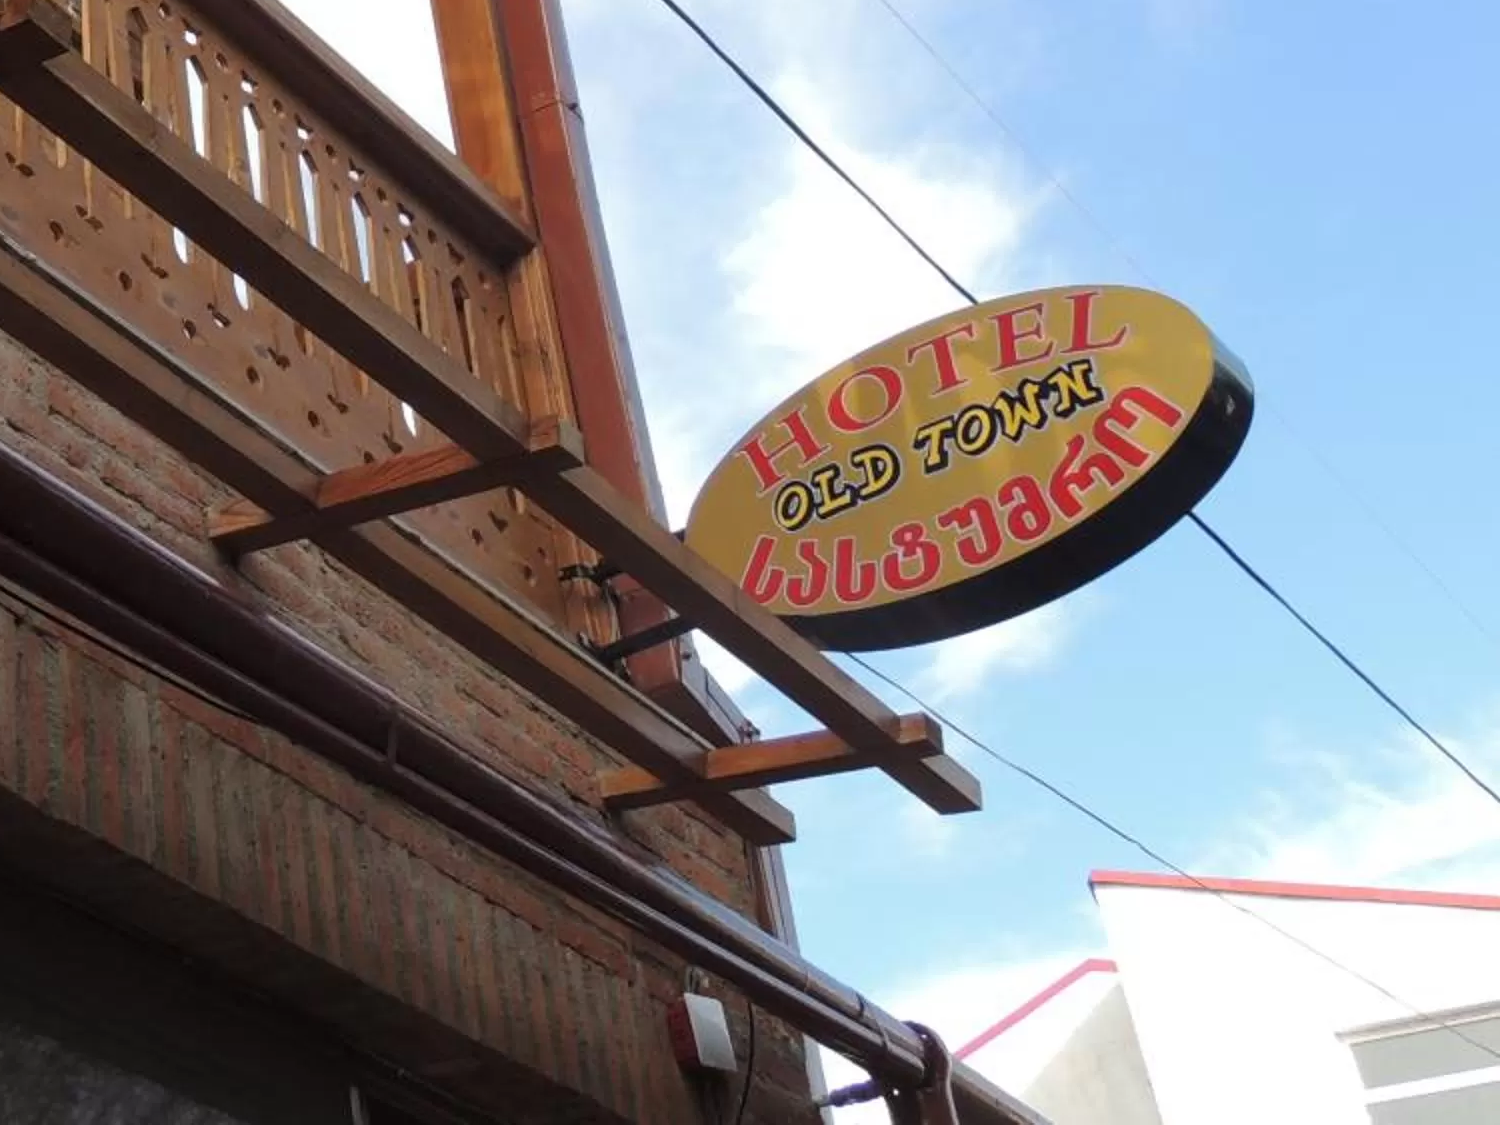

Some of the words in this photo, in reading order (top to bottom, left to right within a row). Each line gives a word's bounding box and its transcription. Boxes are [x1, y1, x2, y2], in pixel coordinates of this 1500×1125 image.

[741, 291, 1128, 492] HOTEL
[774, 444, 901, 531] OLD
[914, 359, 1103, 473] TOWN
[741, 385, 1183, 606] სასტუმრო
